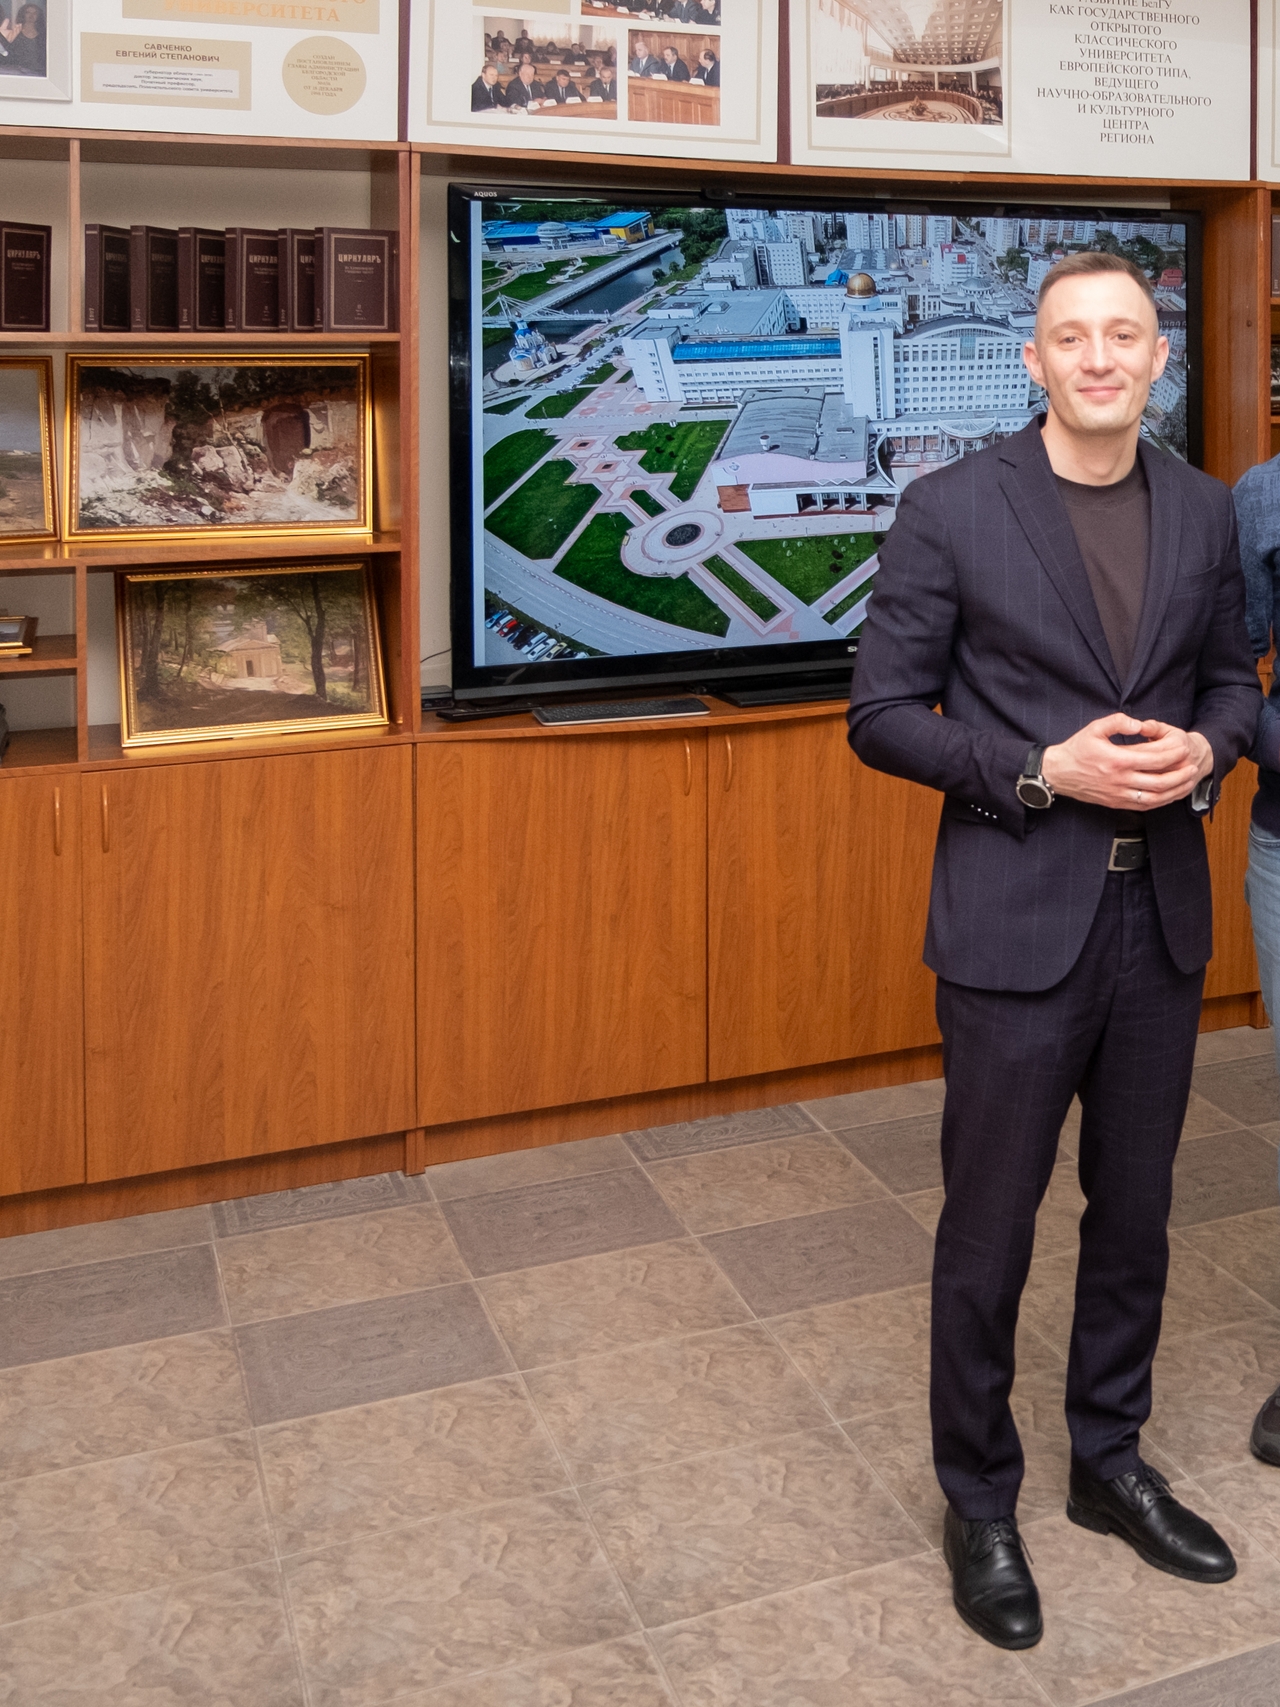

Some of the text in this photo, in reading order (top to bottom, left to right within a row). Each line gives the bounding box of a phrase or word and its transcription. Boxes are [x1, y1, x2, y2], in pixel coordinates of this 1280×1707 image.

[1049, 4, 1200, 25] КАК ГОСУДАРСТВЕННОГО
[1090, 21, 1162, 35] ОТКРЫТОГО
[144, 43, 192, 52] САВЧЕНКО
[1074, 34, 1177, 50] КЛАССИЧЕСКОГО
[115, 50, 220, 62] ЕВГЕНИЙ СТЕПАНОВИЧ
[1079, 48, 1172, 64] УНИВЕРСИТЕТА
[1059, 61, 1191, 79] ЕВРОПЕЙСКОГО ТИПА,
[1094, 77, 1159, 90] ВЕДУЩЕГО
[1037, 88, 1212, 106] НАУЧНО-ОБРАЗОВАТЕЛЬНОГО
[1077, 104, 1175, 118] И КУЛЬТУРНОГО
[1103, 119, 1150, 130] ЦЕНТРА
[1100, 133, 1155, 144] РЕГИОНА
